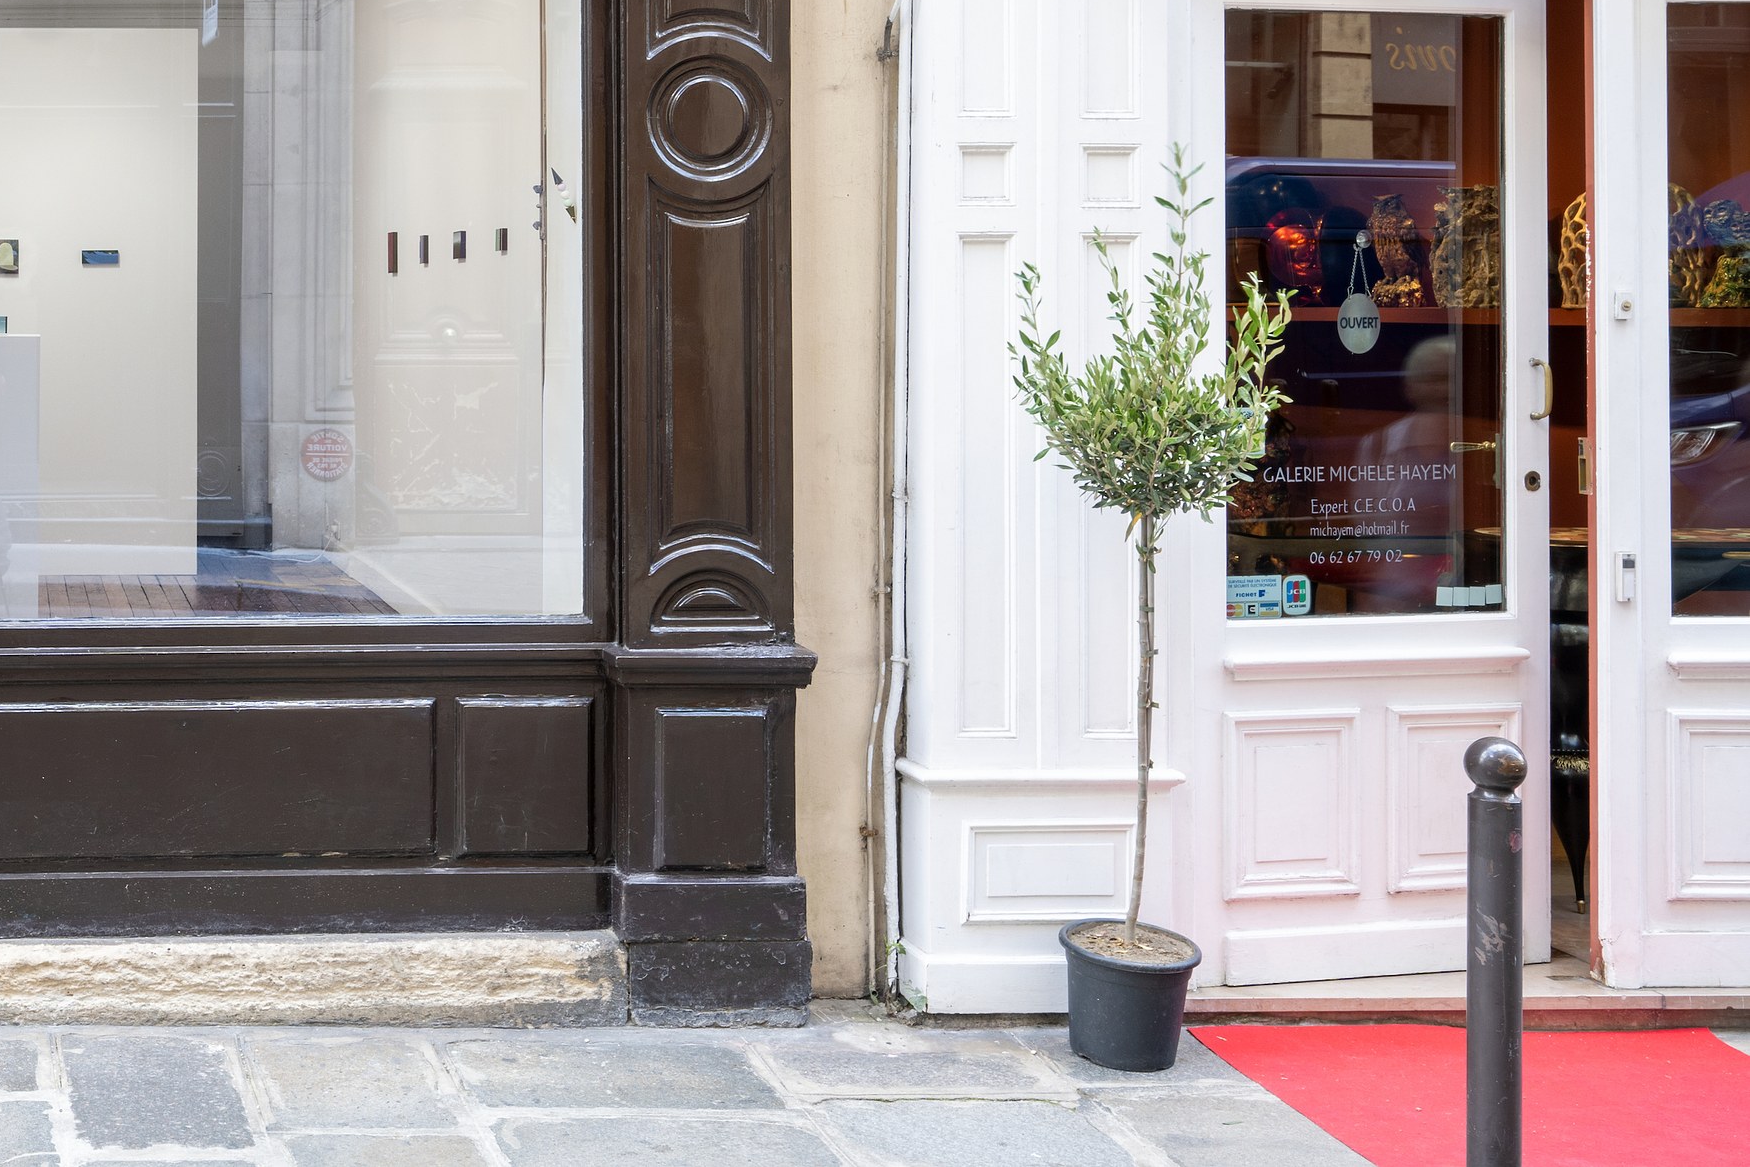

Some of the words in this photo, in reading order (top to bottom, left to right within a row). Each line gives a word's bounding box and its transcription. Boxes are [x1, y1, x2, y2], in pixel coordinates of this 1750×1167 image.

[1340, 317, 1379, 329] OUVERT
[1263, 466, 1325, 483] GALERIE
[1329, 465, 1395, 481] MICHELE
[1400, 464, 1457, 480] HAYEM
[1311, 498, 1349, 518] Expert
[1354, 497, 1416, 513] C.E.C.O.A
[1310, 520, 1410, 541] michayem@hotmail.fr
[1309, 550, 1325, 564] 06
[1329, 550, 1343, 564] 62
[1347, 550, 1361, 563] 67
[1366, 549, 1381, 563] 79
[1385, 549, 1402, 563] 02
